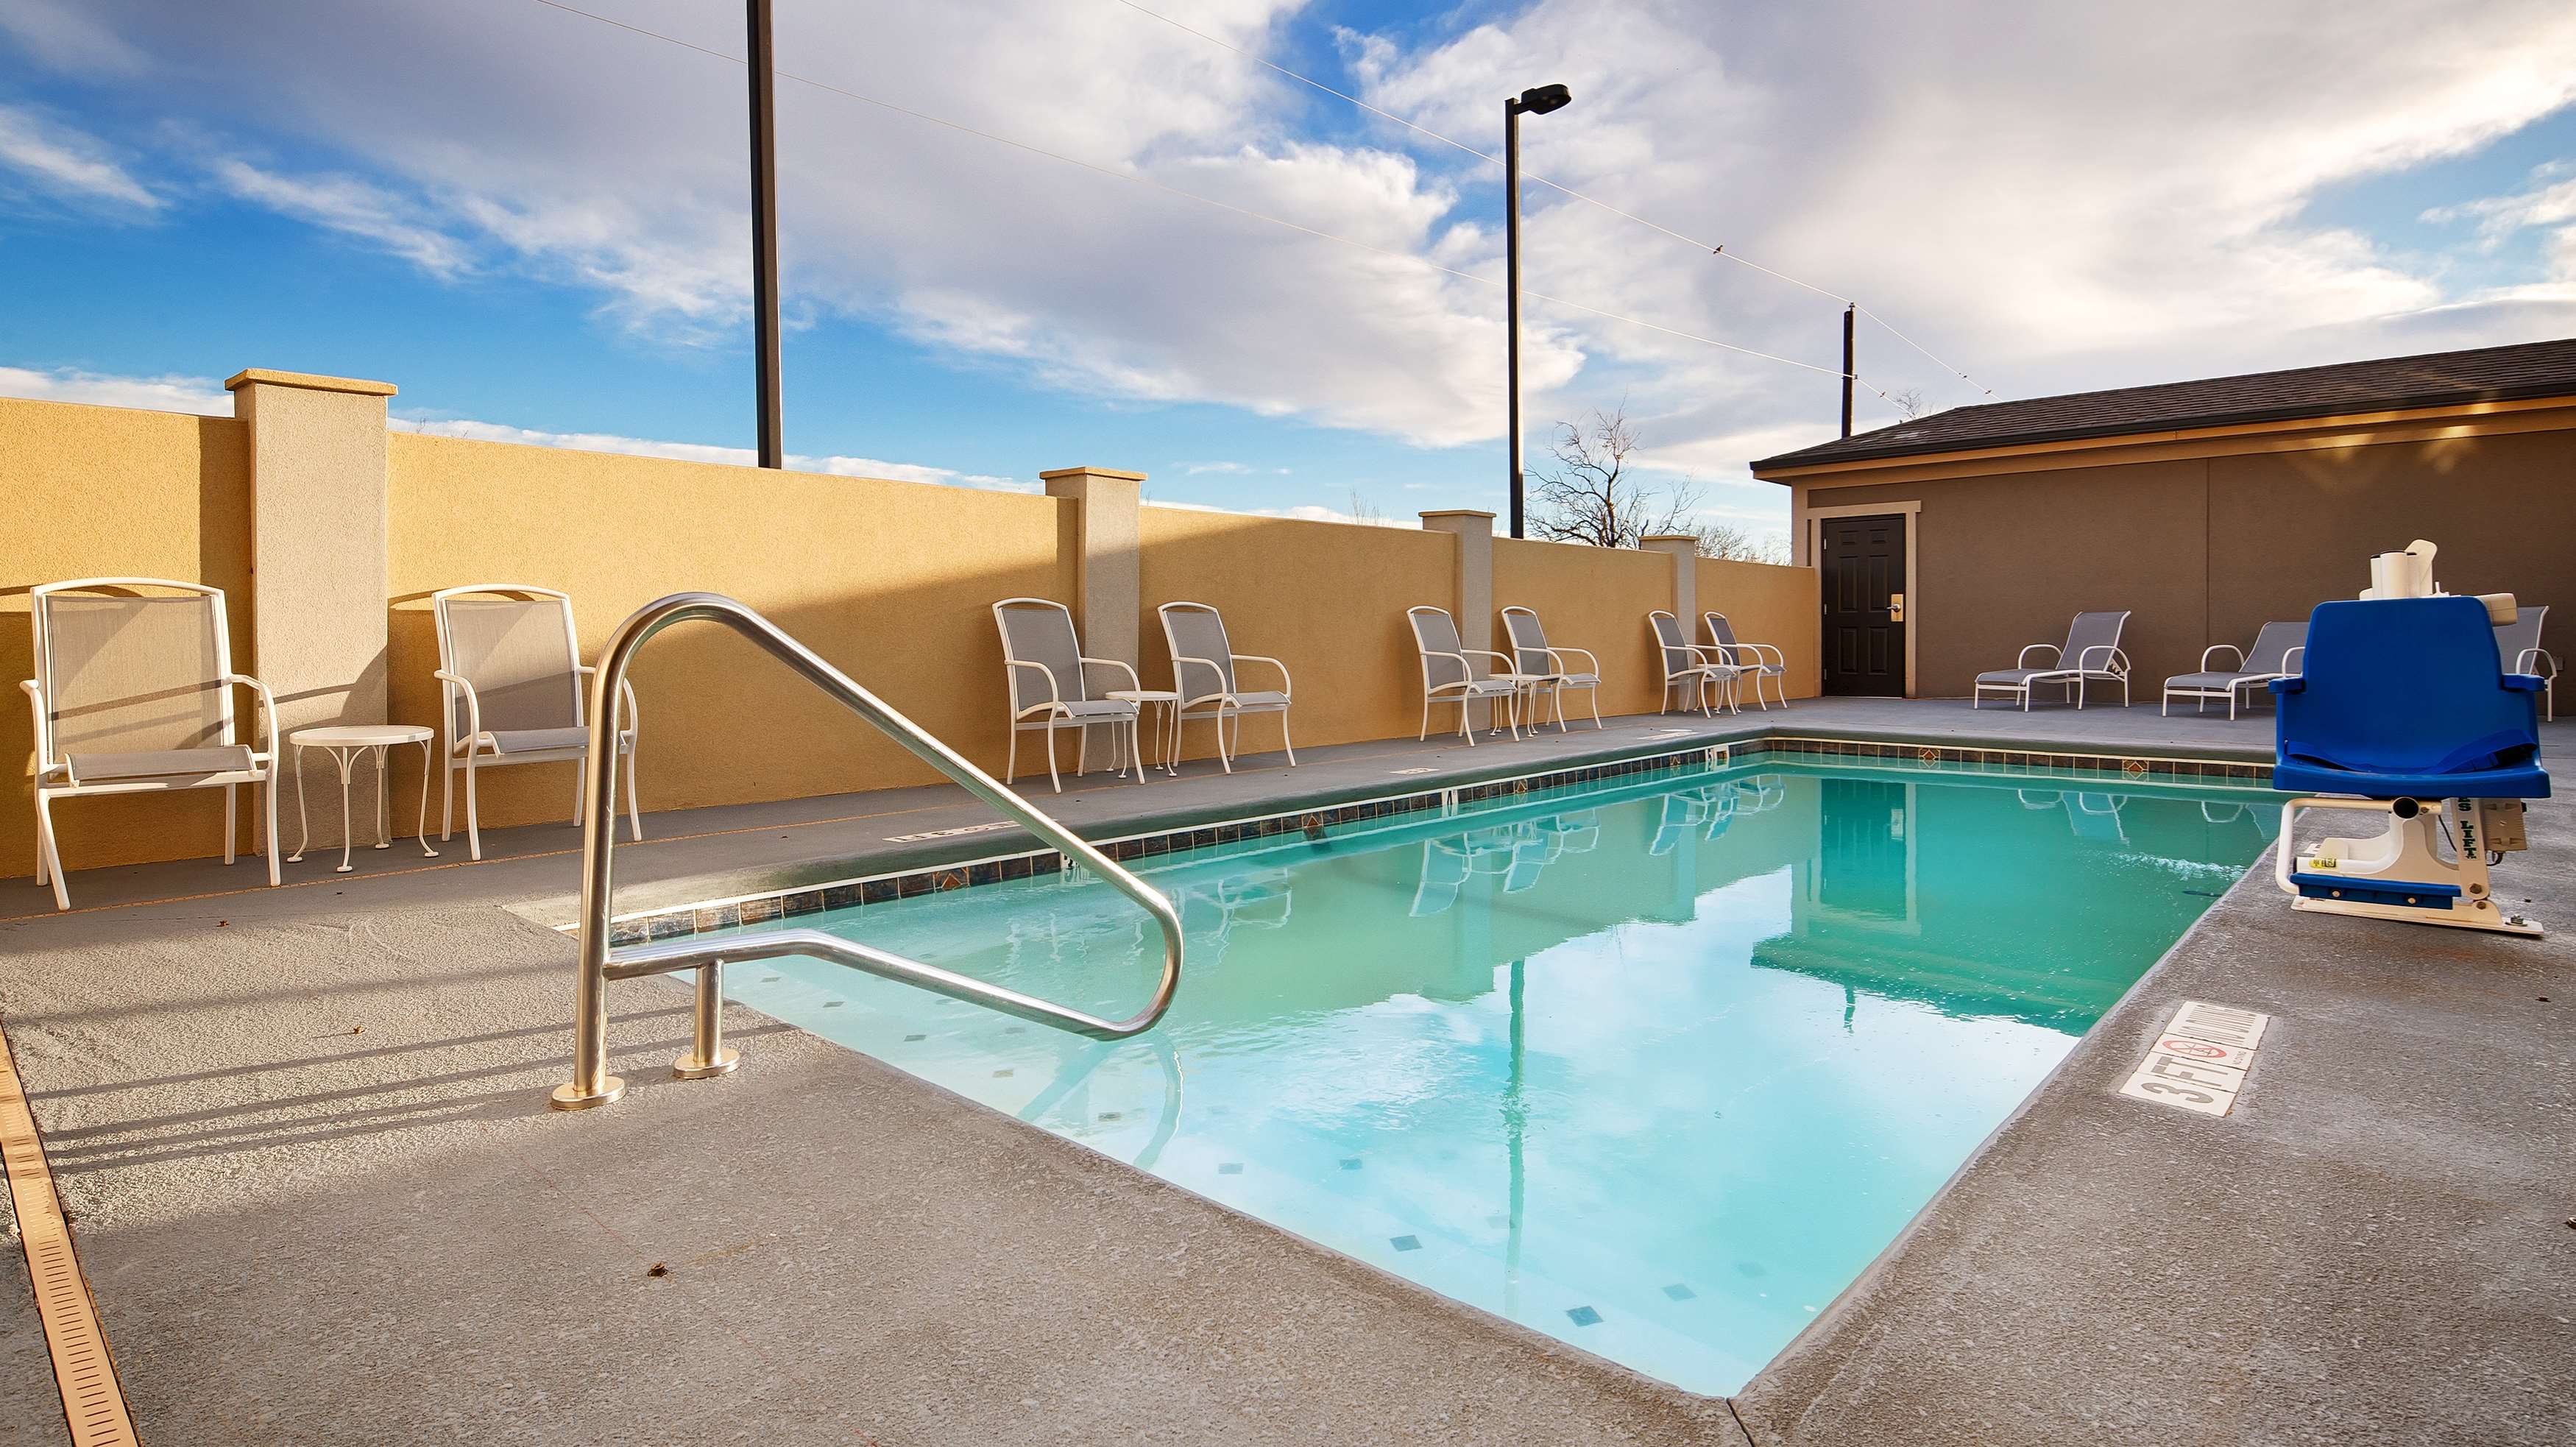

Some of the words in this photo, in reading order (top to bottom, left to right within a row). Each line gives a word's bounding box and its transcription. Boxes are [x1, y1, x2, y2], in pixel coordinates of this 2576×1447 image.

[2460, 821, 2477, 856] LIFT
[2151, 1055, 2229, 1089] FT
[2141, 1082, 2214, 1103] 3
